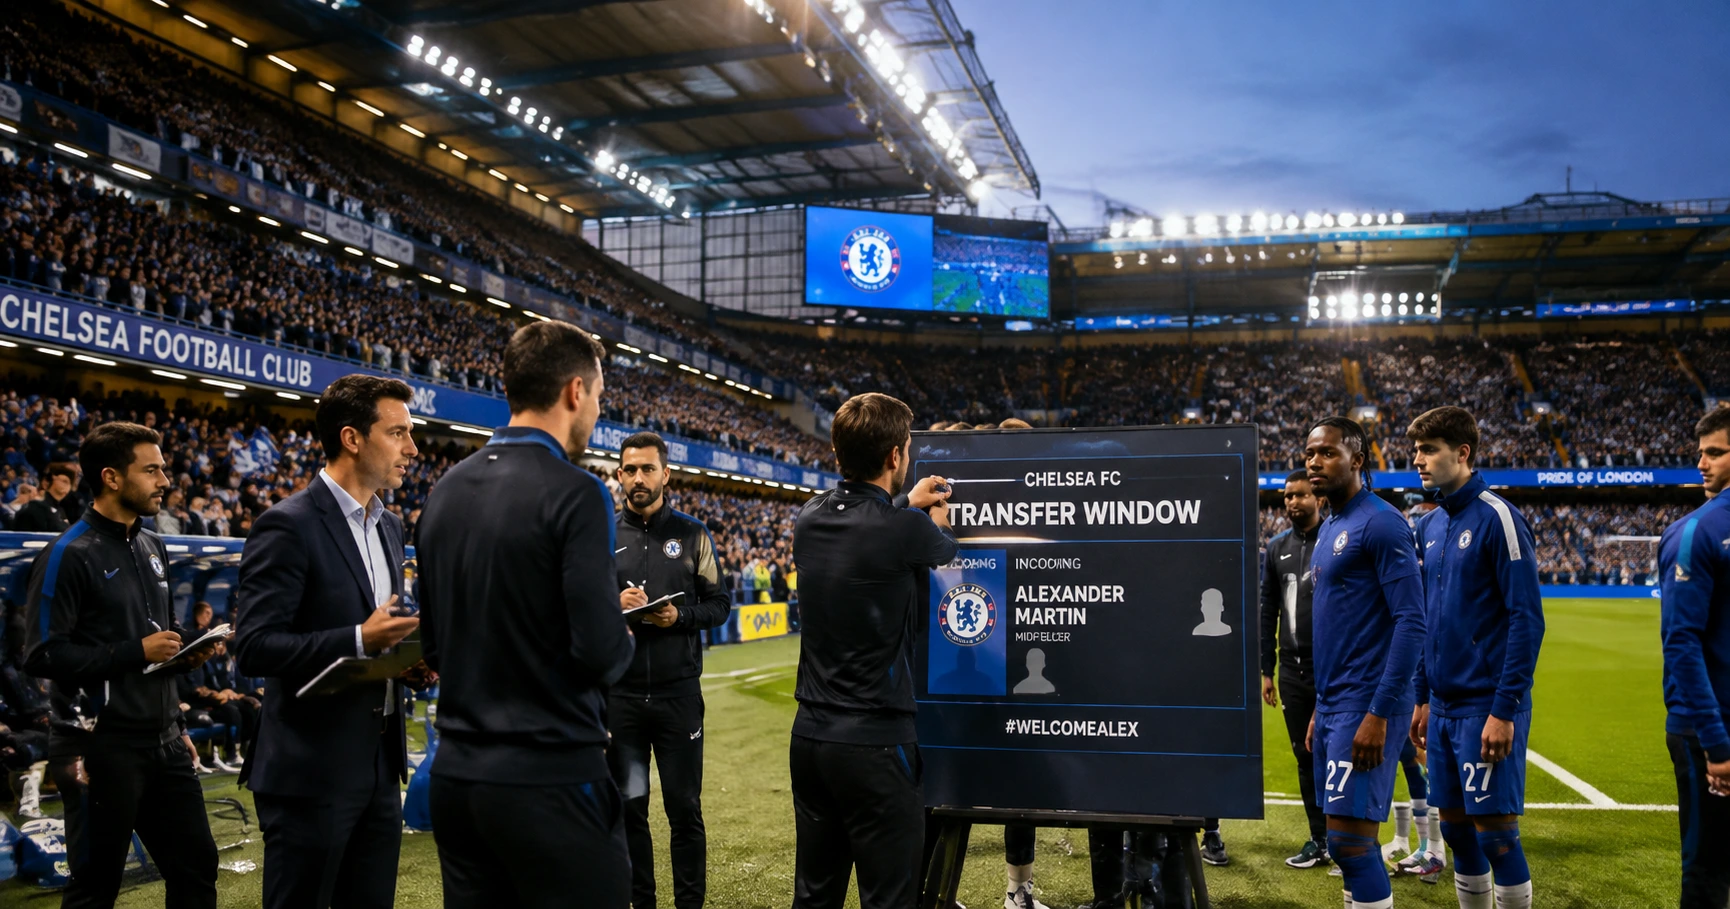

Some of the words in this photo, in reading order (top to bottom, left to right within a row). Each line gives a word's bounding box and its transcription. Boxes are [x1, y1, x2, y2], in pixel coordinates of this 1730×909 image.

[0, 294, 130, 353] CHELSEA
[138, 324, 256, 378] FOOTBALL
[262, 352, 312, 388] CLUB
[1024, 471, 1097, 488] CHELSEA
[1100, 470, 1121, 486] FC
[1537, 472, 1574, 484] PRIDE
[1577, 472, 1593, 484] OF
[1597, 471, 1654, 483] LONDON
[949, 501, 1076, 526] TRANSFER
[1083, 499, 1201, 525] WINDOW
[1015, 585, 1125, 603] ALEXANDER
[1015, 607, 1087, 625] MARTIN
[1005, 718, 1139, 738] #WELCOMEALEX
[1325, 759, 1353, 792] 27
[1463, 762, 1492, 792] 27
